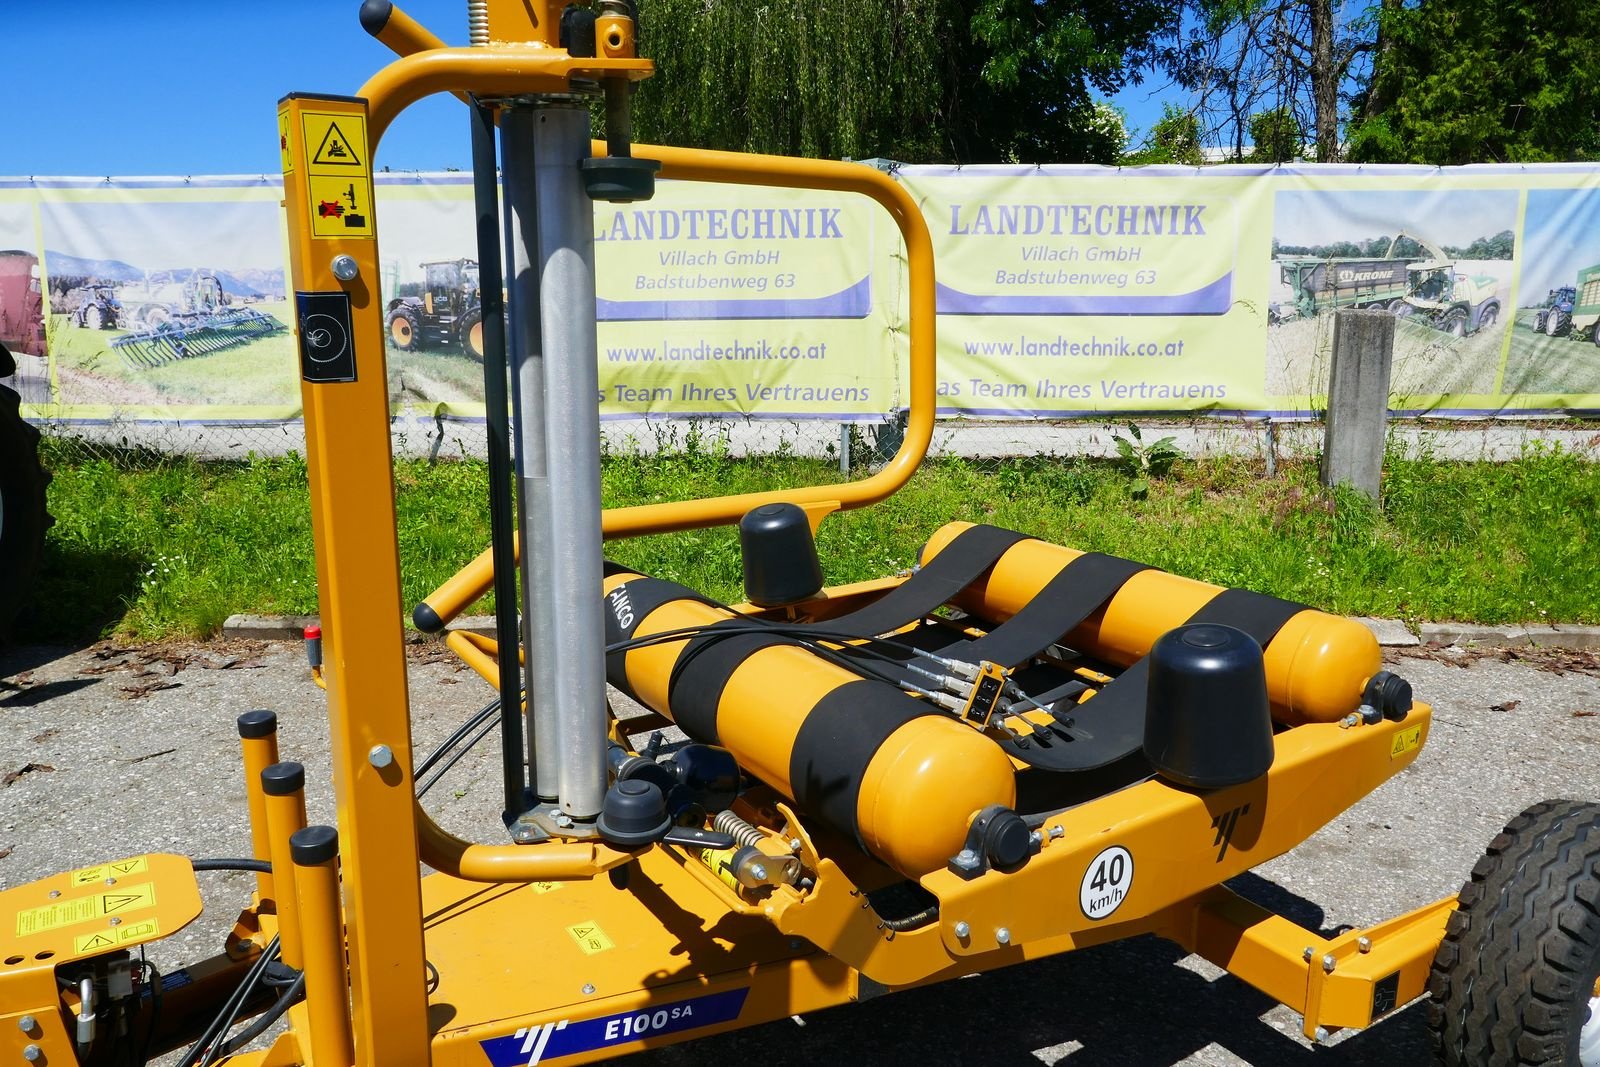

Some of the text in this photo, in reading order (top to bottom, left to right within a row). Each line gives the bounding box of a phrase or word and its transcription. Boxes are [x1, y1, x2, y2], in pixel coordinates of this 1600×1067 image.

[949, 204, 1207, 236] LANDTECHNIK
[659, 250, 780, 266] Villach GmbH
[1022, 246, 1141, 261] Villach GmbH
[635, 274, 796, 291] Badstubenweg 63
[996, 270, 1156, 288] Badstubenweg 63
[1354, 270, 1394, 281] KRONE
[607, 340, 827, 361] www.landtechnik.co.at
[964, 336, 1184, 357] www.landtechnik.co.at
[614, 384, 673, 402] Team
[682, 382, 737, 401] Ihres
[746, 383, 869, 402] Vertrauens
[937, 379, 1227, 399] as Team Ihres Vertrauens
[1090, 854, 1125, 892] 40
[1089, 888, 1123, 913] km/h
[604, 1005, 693, 1041] E100 SA
